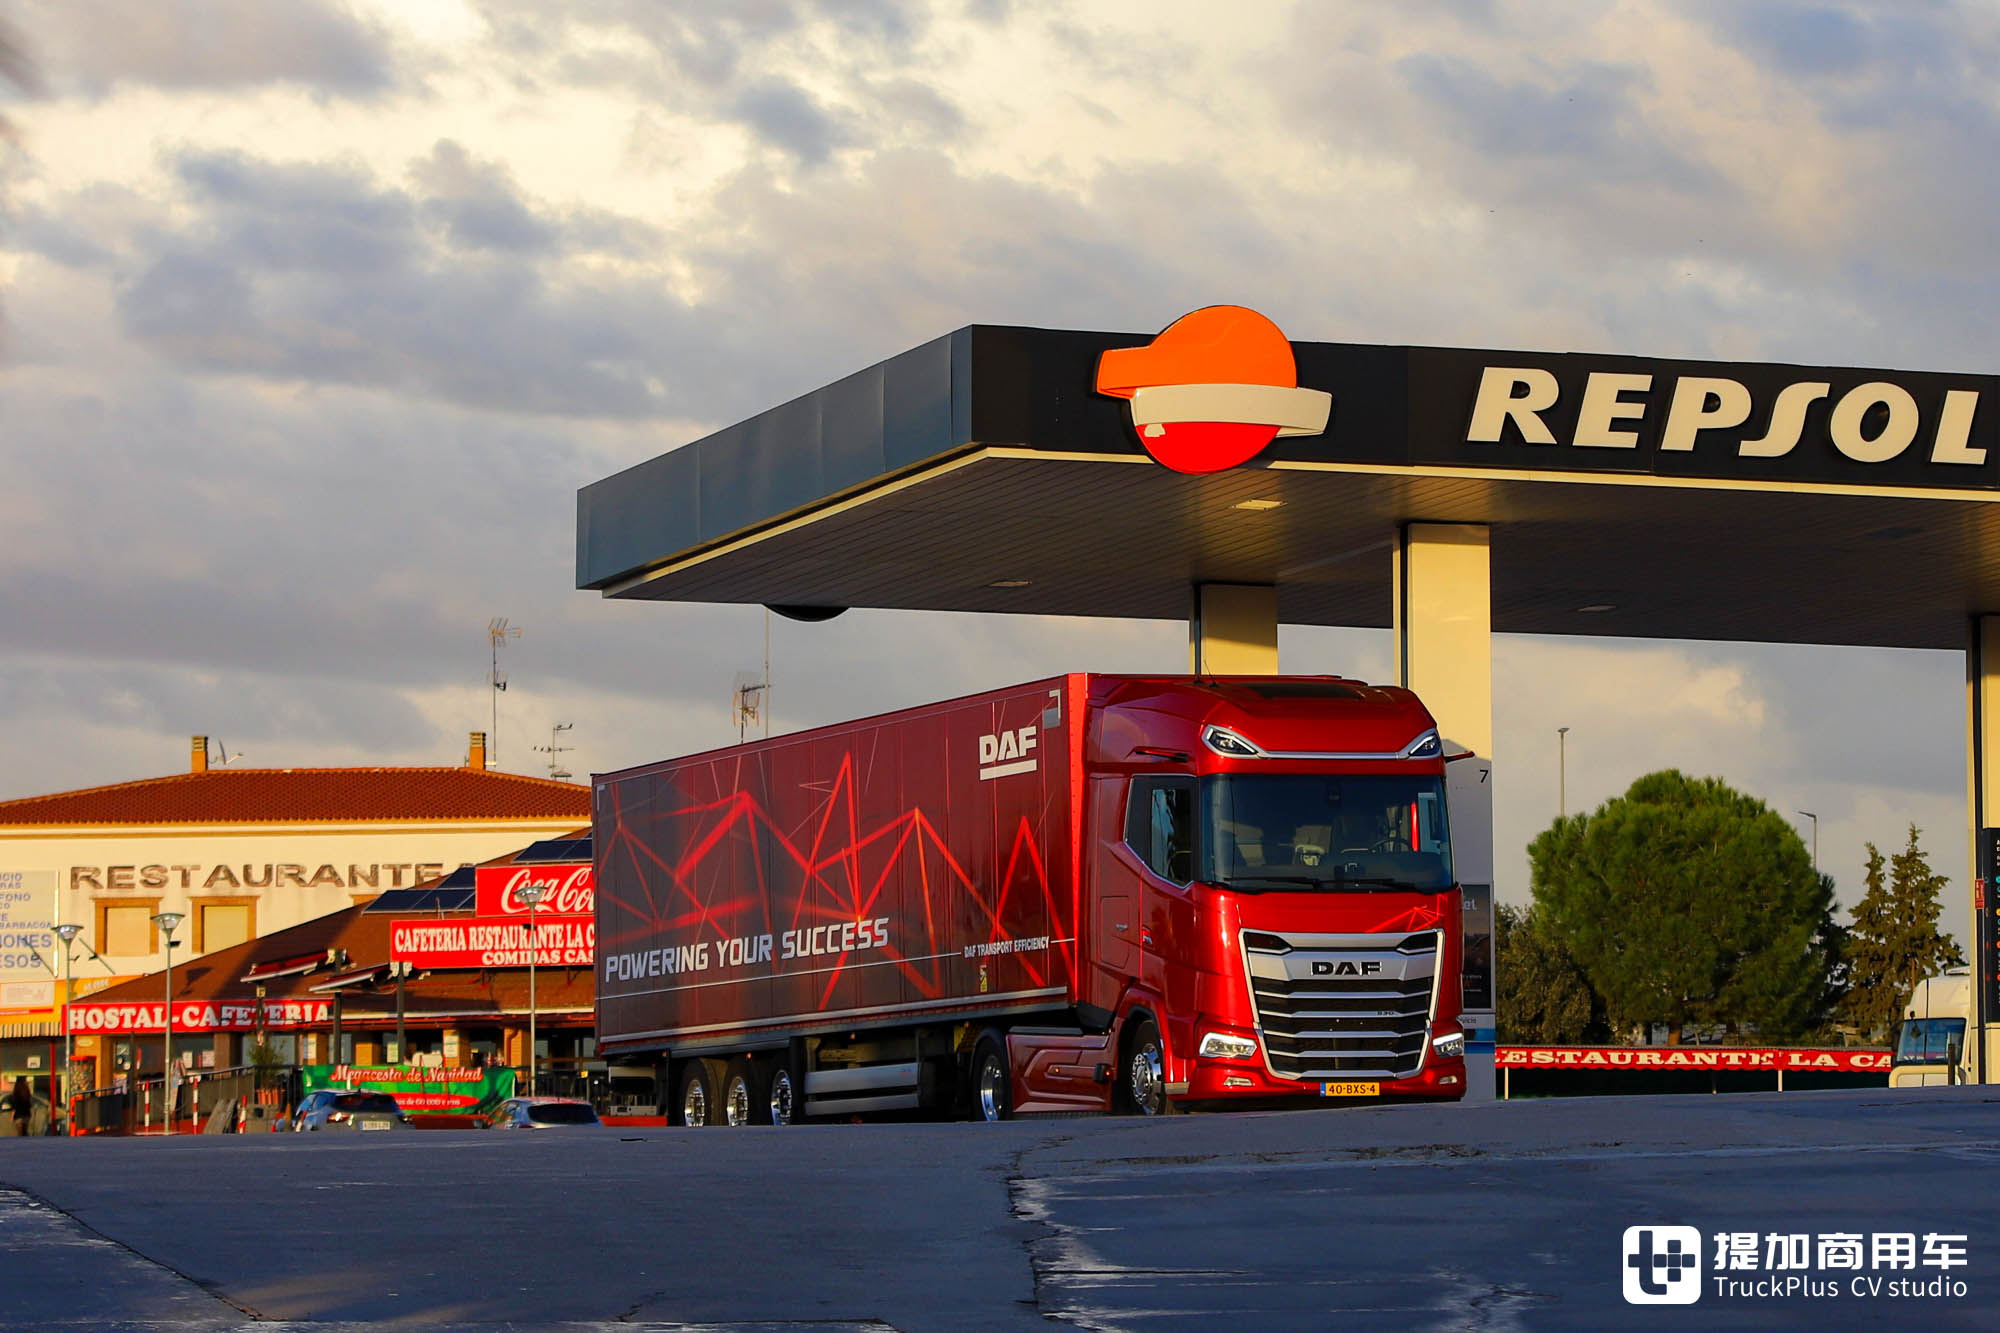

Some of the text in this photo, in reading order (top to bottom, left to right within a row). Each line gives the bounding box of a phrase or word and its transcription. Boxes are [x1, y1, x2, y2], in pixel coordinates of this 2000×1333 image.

[1467, 366, 1988, 465] REPSOL
[979, 726, 1037, 765] DAF
[1479, 769, 1489, 783] 7
[70, 863, 444, 890] RESTAURANTE
[501, 869, 560, 913] Coa
[394, 927, 467, 953] CAFETERIA
[468, 923, 564, 951] RESTAURANTE
[566, 923, 584, 949] LA
[605, 917, 889, 983] POWERING YOUR SUCCESS
[964, 935, 1050, 959] DAF TRANSPORT EFFICIENCY
[481, 949, 561, 965] COMIDAS
[1311, 961, 1382, 976] DAF
[1495, 1050, 1774, 1065] ESTAURANTE
[1788, 1053, 1839, 1066] LA
[407, 1067, 422, 1082] de
[1328, 1083, 1376, 1095] 40-BXS-4
